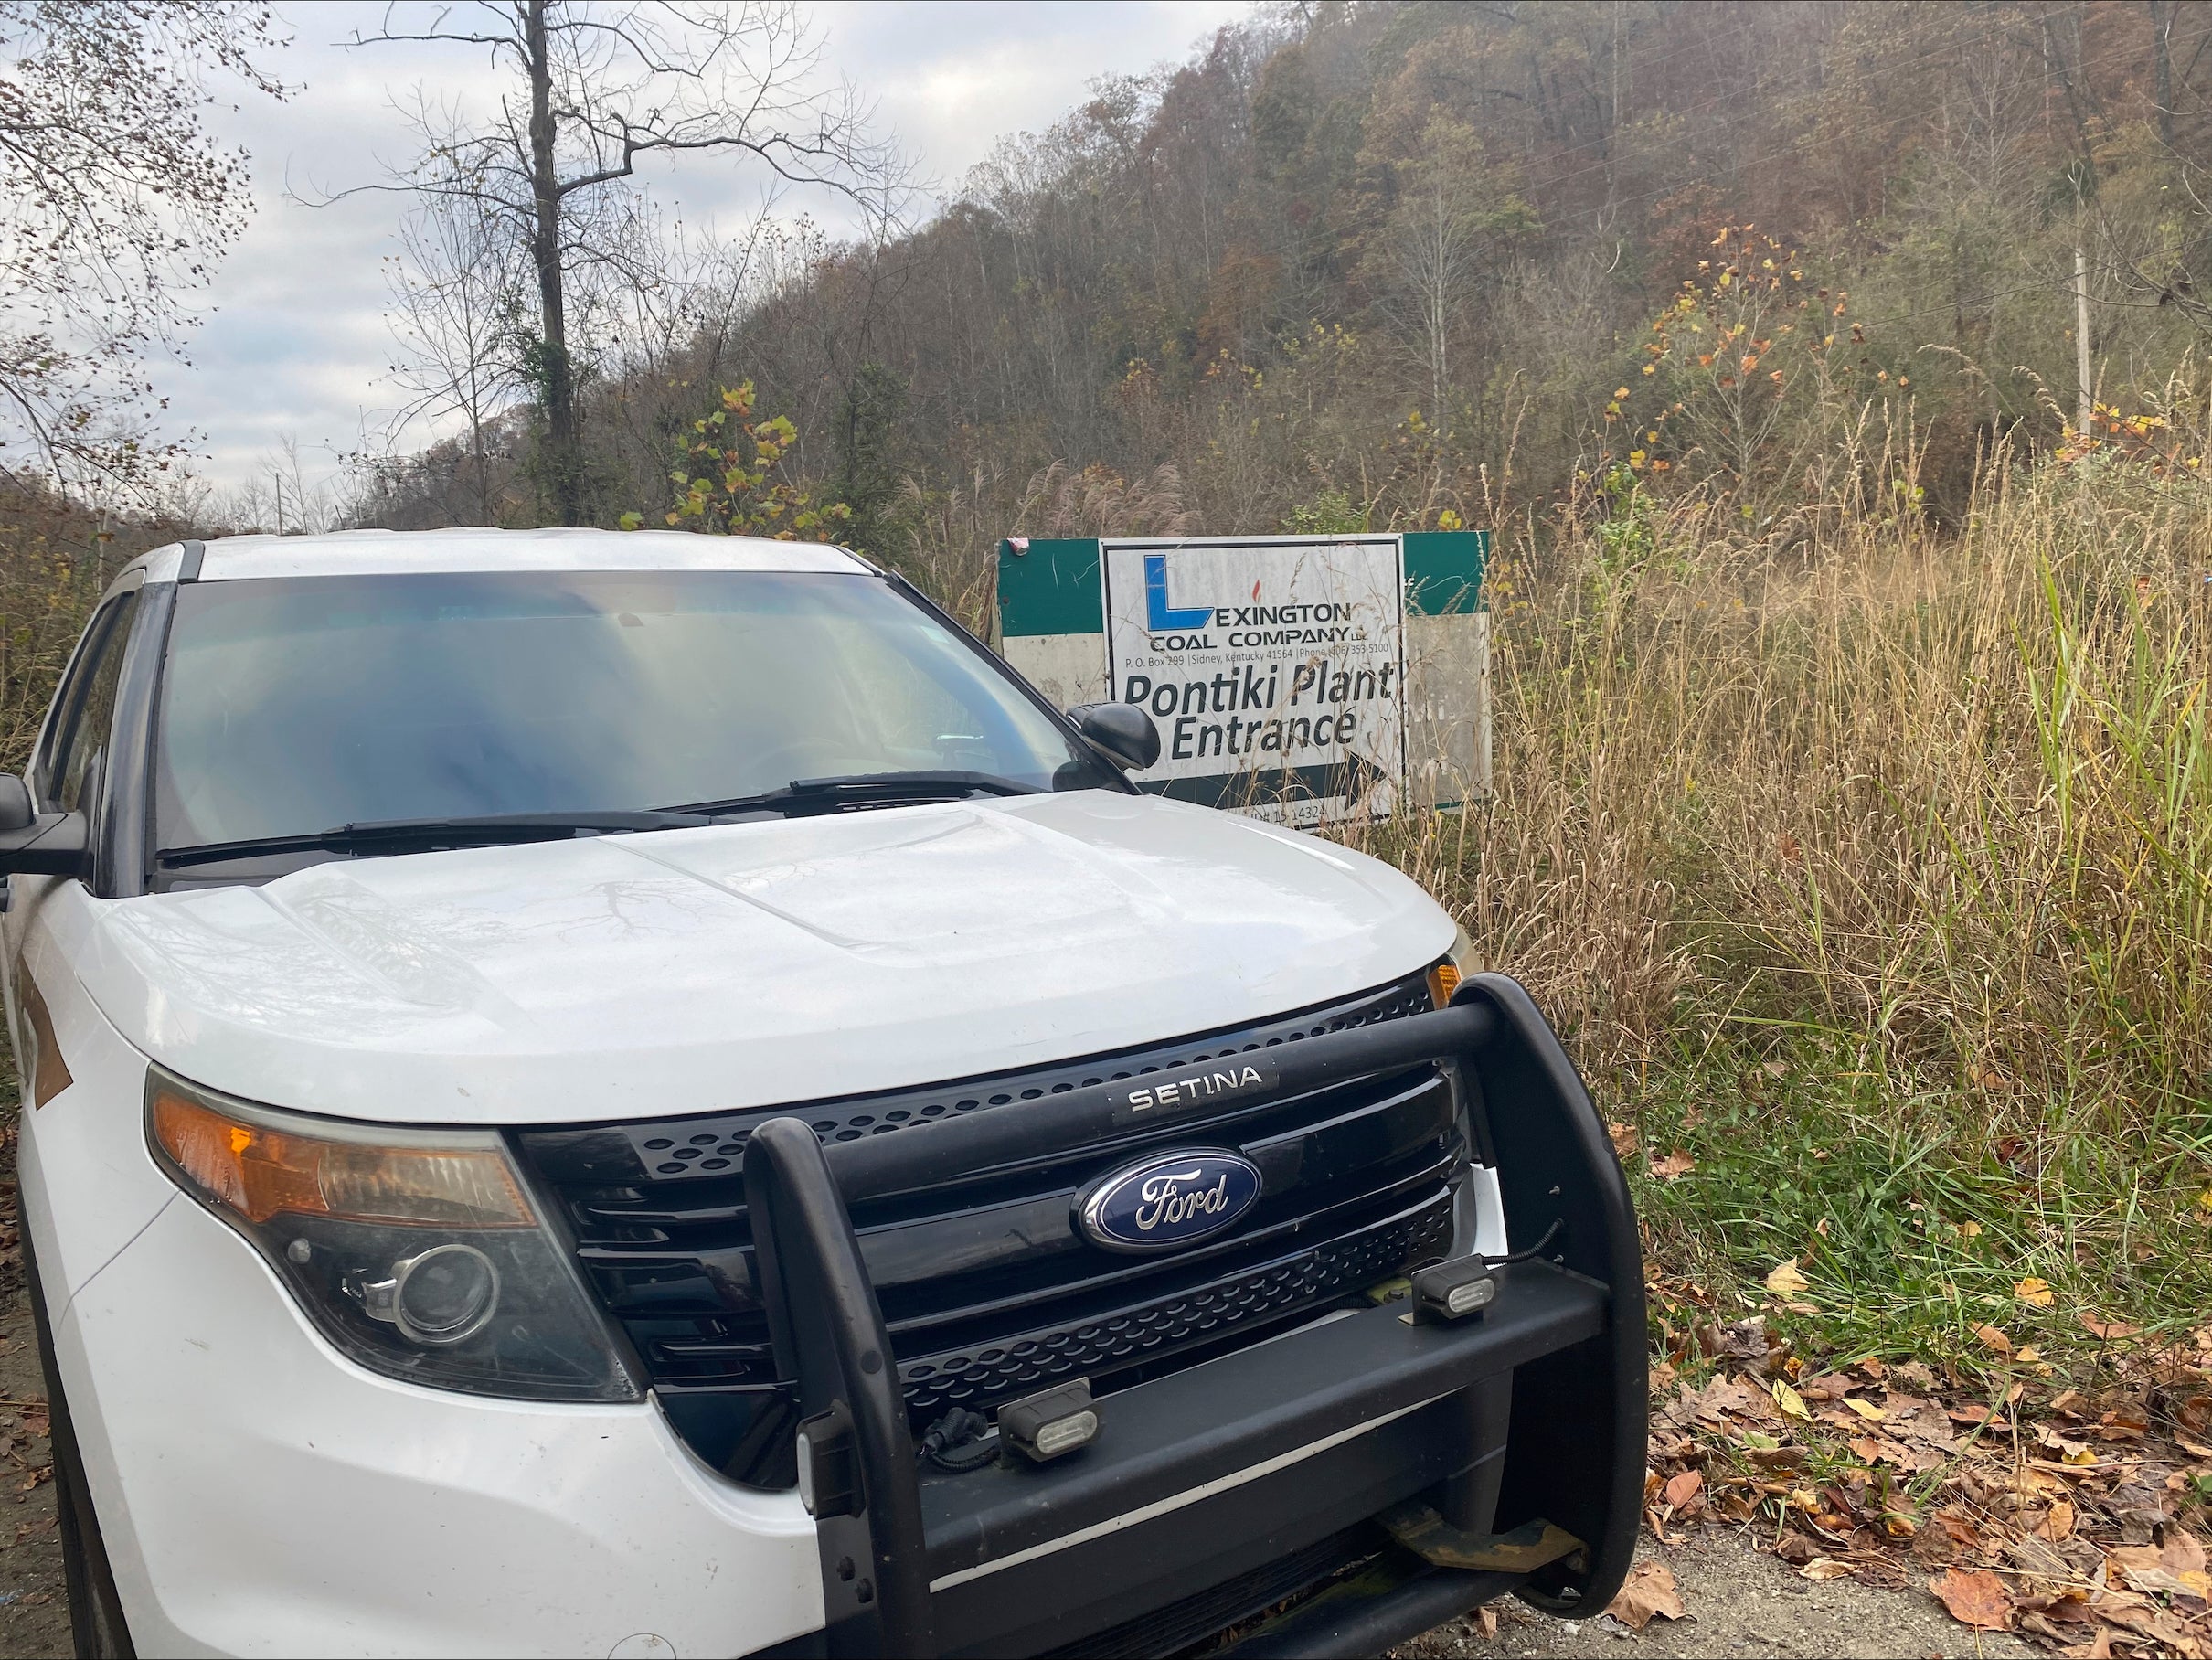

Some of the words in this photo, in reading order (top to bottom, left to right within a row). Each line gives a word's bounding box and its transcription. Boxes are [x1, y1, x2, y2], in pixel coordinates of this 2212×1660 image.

[1144, 554, 1351, 633] LEXINGTON
[1125, 657, 1133, 668] P.
[1135, 657, 1146, 667] O.
[1148, 656, 1165, 667] Box
[1167, 654, 1185, 666] 299
[1225, 650, 1264, 662] Kentucky
[1266, 649, 1292, 660] 41564
[1351, 643, 1389, 654] 353-5100
[1150, 633, 1218, 651] COAL
[1228, 626, 1351, 646] COMPANY
[1124, 665, 1278, 718] Pontiki
[1291, 660, 1394, 707] Plant
[1172, 712, 1356, 760] Entrance
[1128, 1066, 1262, 1112] SETINA
[1135, 1168, 1229, 1231] Ford
